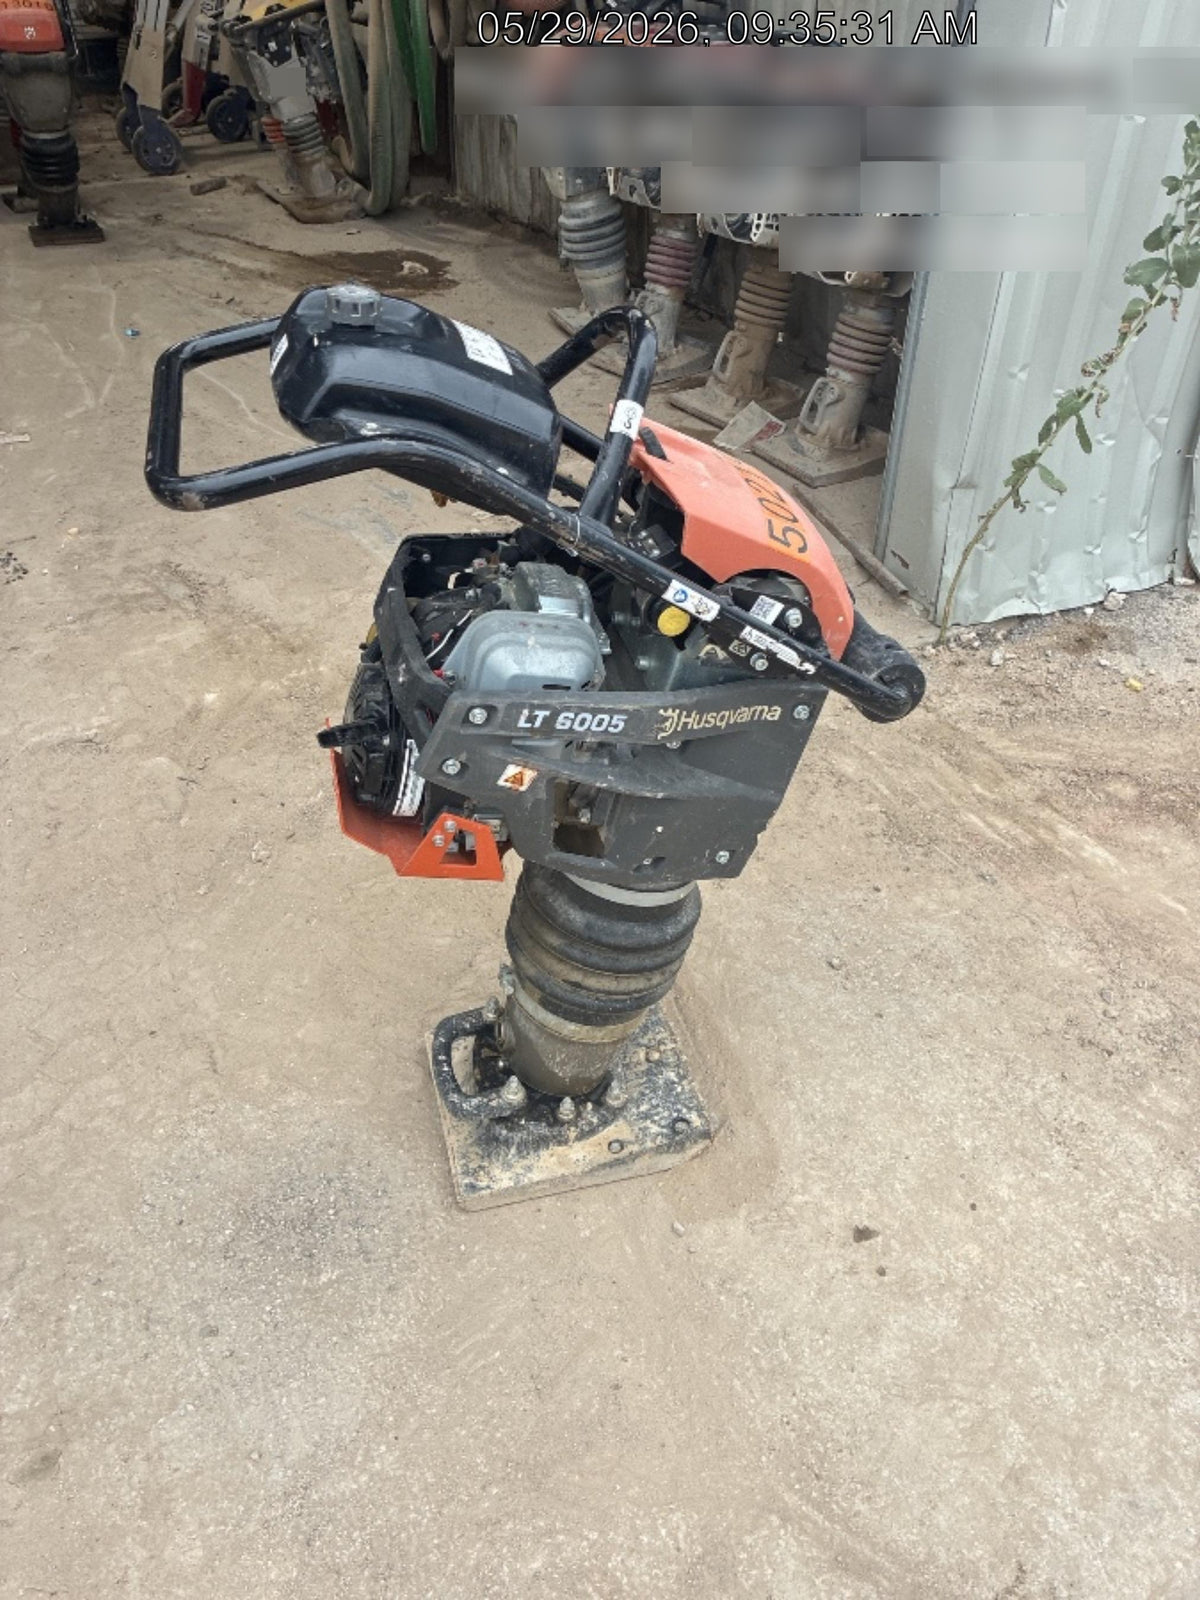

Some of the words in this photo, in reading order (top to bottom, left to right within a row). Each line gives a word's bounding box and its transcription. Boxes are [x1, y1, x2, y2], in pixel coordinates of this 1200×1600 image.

[517, 709, 549, 728] LT
[555, 712, 628, 733] 6005
[677, 704, 782, 731] Husqvarna
